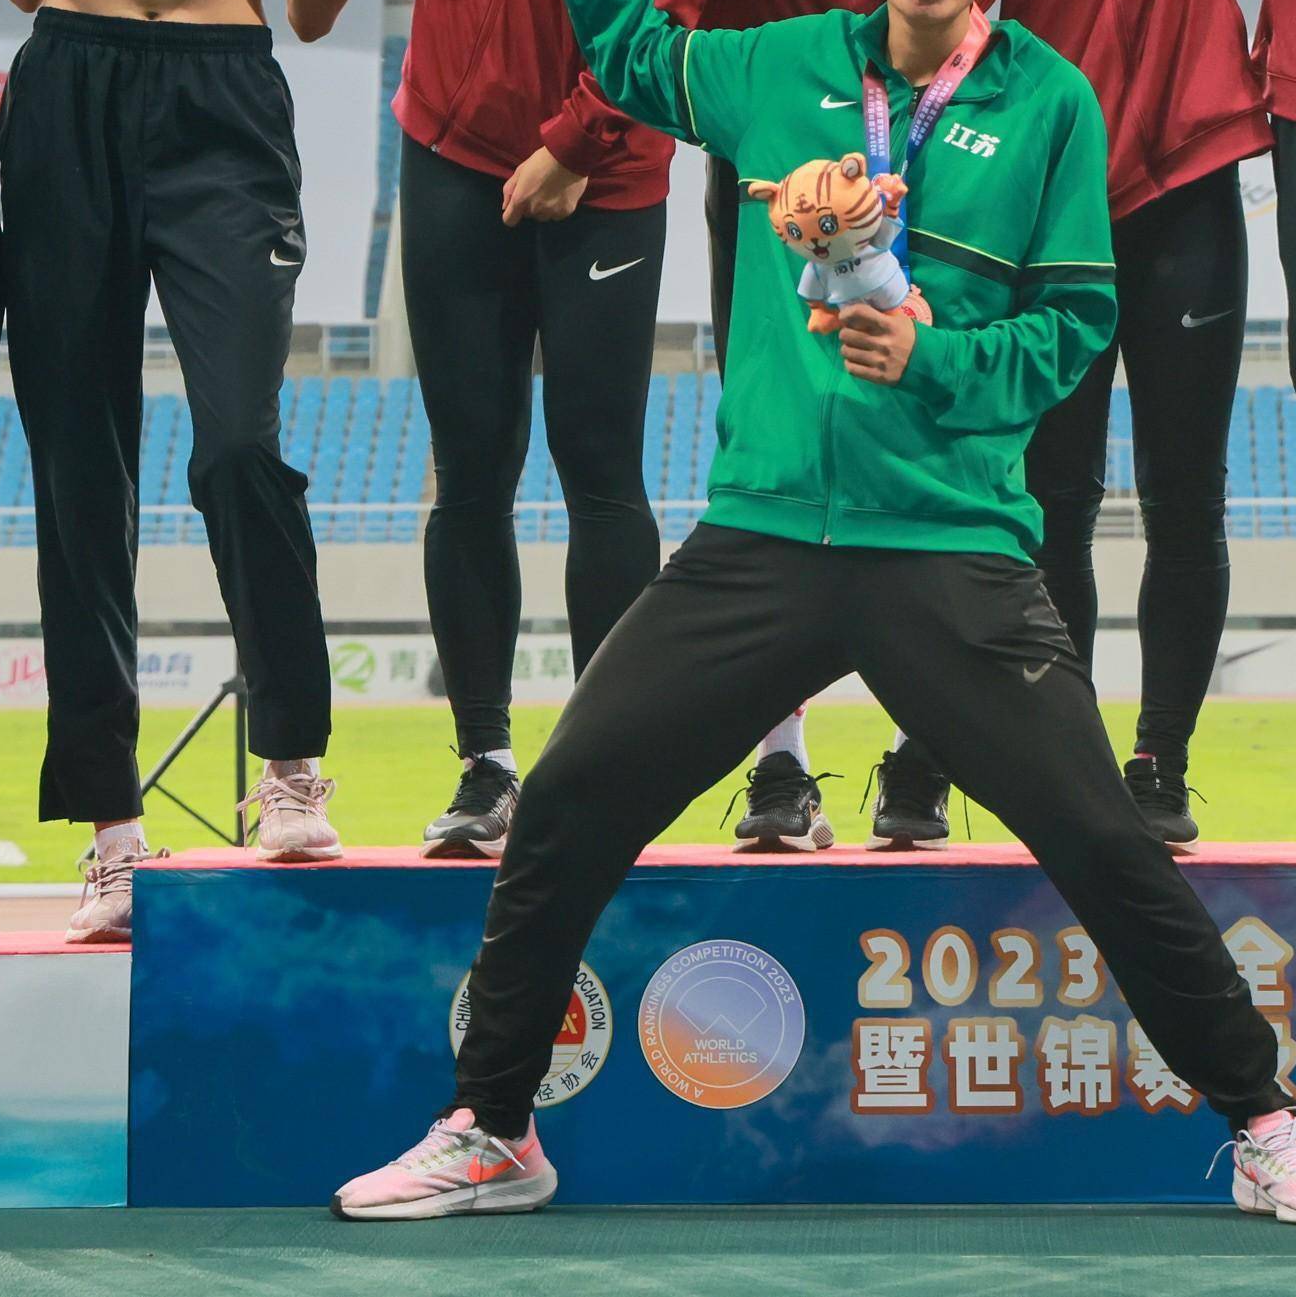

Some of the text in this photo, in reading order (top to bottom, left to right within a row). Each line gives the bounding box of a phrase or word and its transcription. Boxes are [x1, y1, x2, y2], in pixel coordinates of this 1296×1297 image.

[943, 121, 1001, 159] 江苏
[671, 945, 769, 974] COMPETITION
[575, 972, 607, 1031] OCIATION
[767, 967, 796, 1004] 2023
[456, 990, 473, 1032] CHIN
[644, 972, 673, 1047] RANKINGS
[682, 1051, 759, 1064] ATHLETICS
[694, 1039, 746, 1051] WORLD
[536, 1050, 600, 1103] 径协会
[650, 1049, 689, 1094] WORLD
